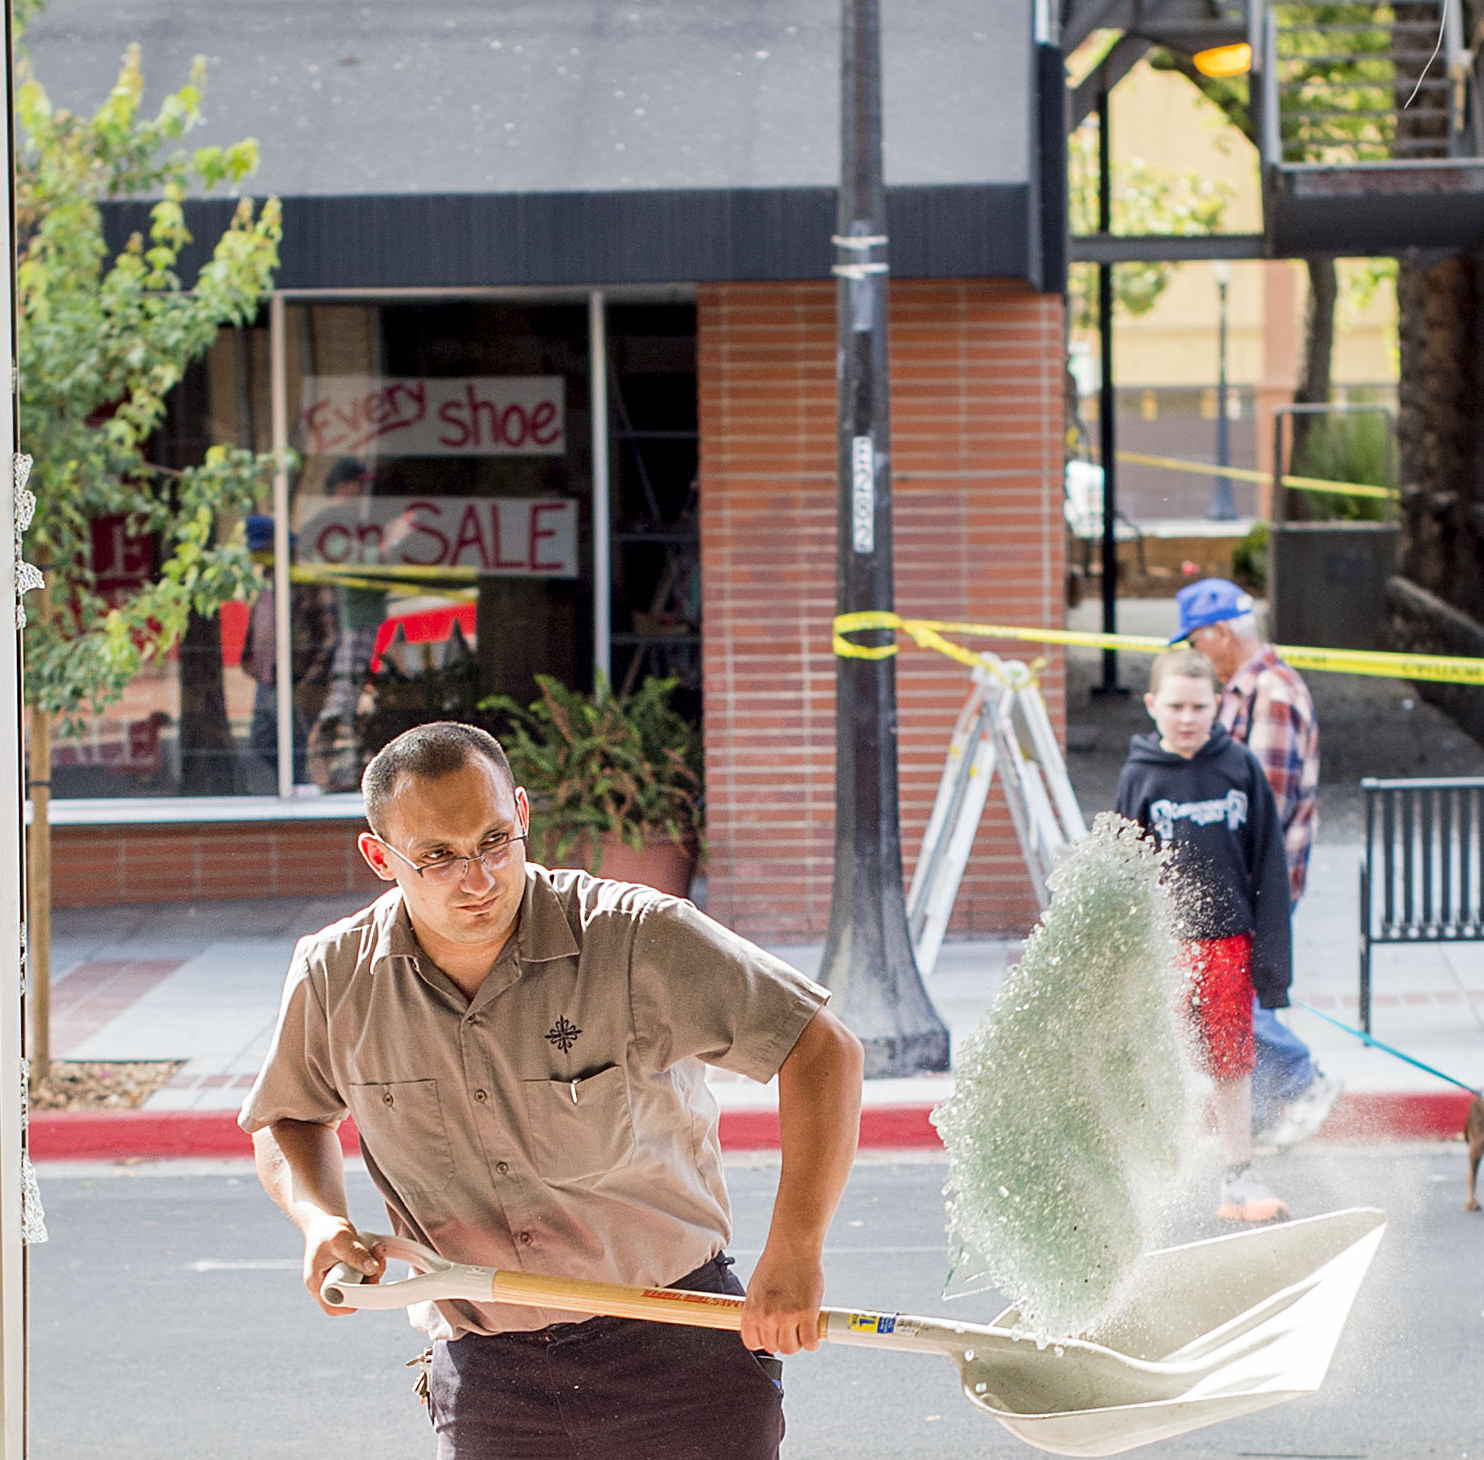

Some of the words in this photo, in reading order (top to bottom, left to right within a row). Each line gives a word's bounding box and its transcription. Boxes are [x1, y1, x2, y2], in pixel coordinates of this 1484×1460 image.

[307, 380, 428, 452] Every
[438, 384, 563, 448] shoe
[316, 523, 386, 565] on
[399, 500, 568, 572] SALE
